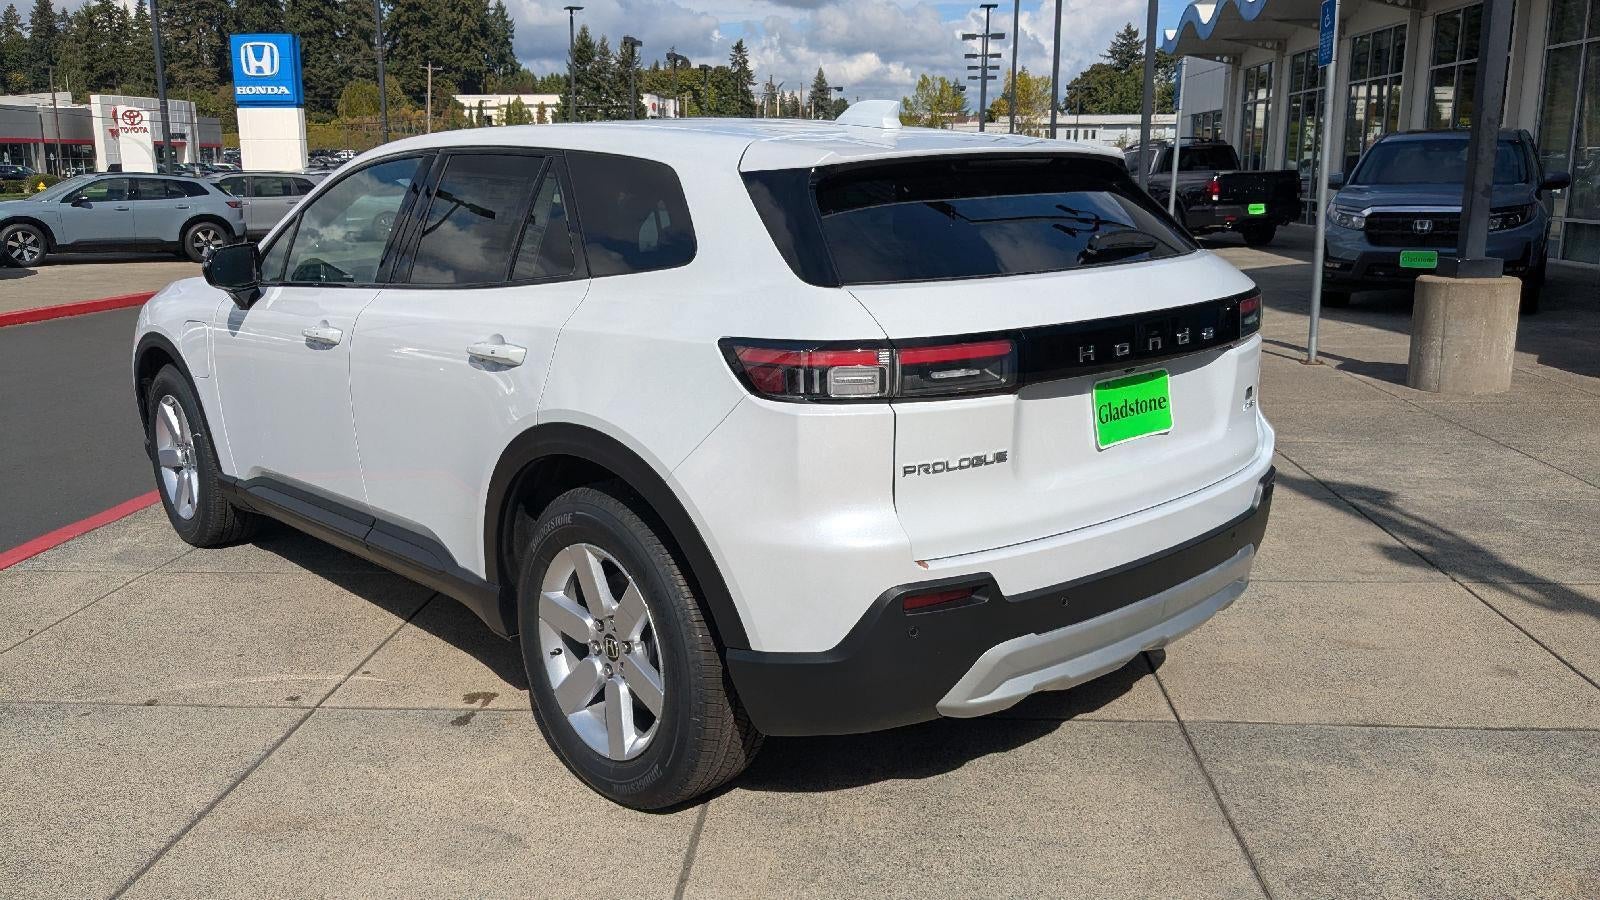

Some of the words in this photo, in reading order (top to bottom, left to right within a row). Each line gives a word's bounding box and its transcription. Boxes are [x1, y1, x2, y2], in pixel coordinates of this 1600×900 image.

[236, 86, 290, 95] HONDA
[119, 126, 149, 134] TOYOTA
[1098, 396, 1167, 425] Gladstone
[902, 450, 1008, 478] PROLOGUE
